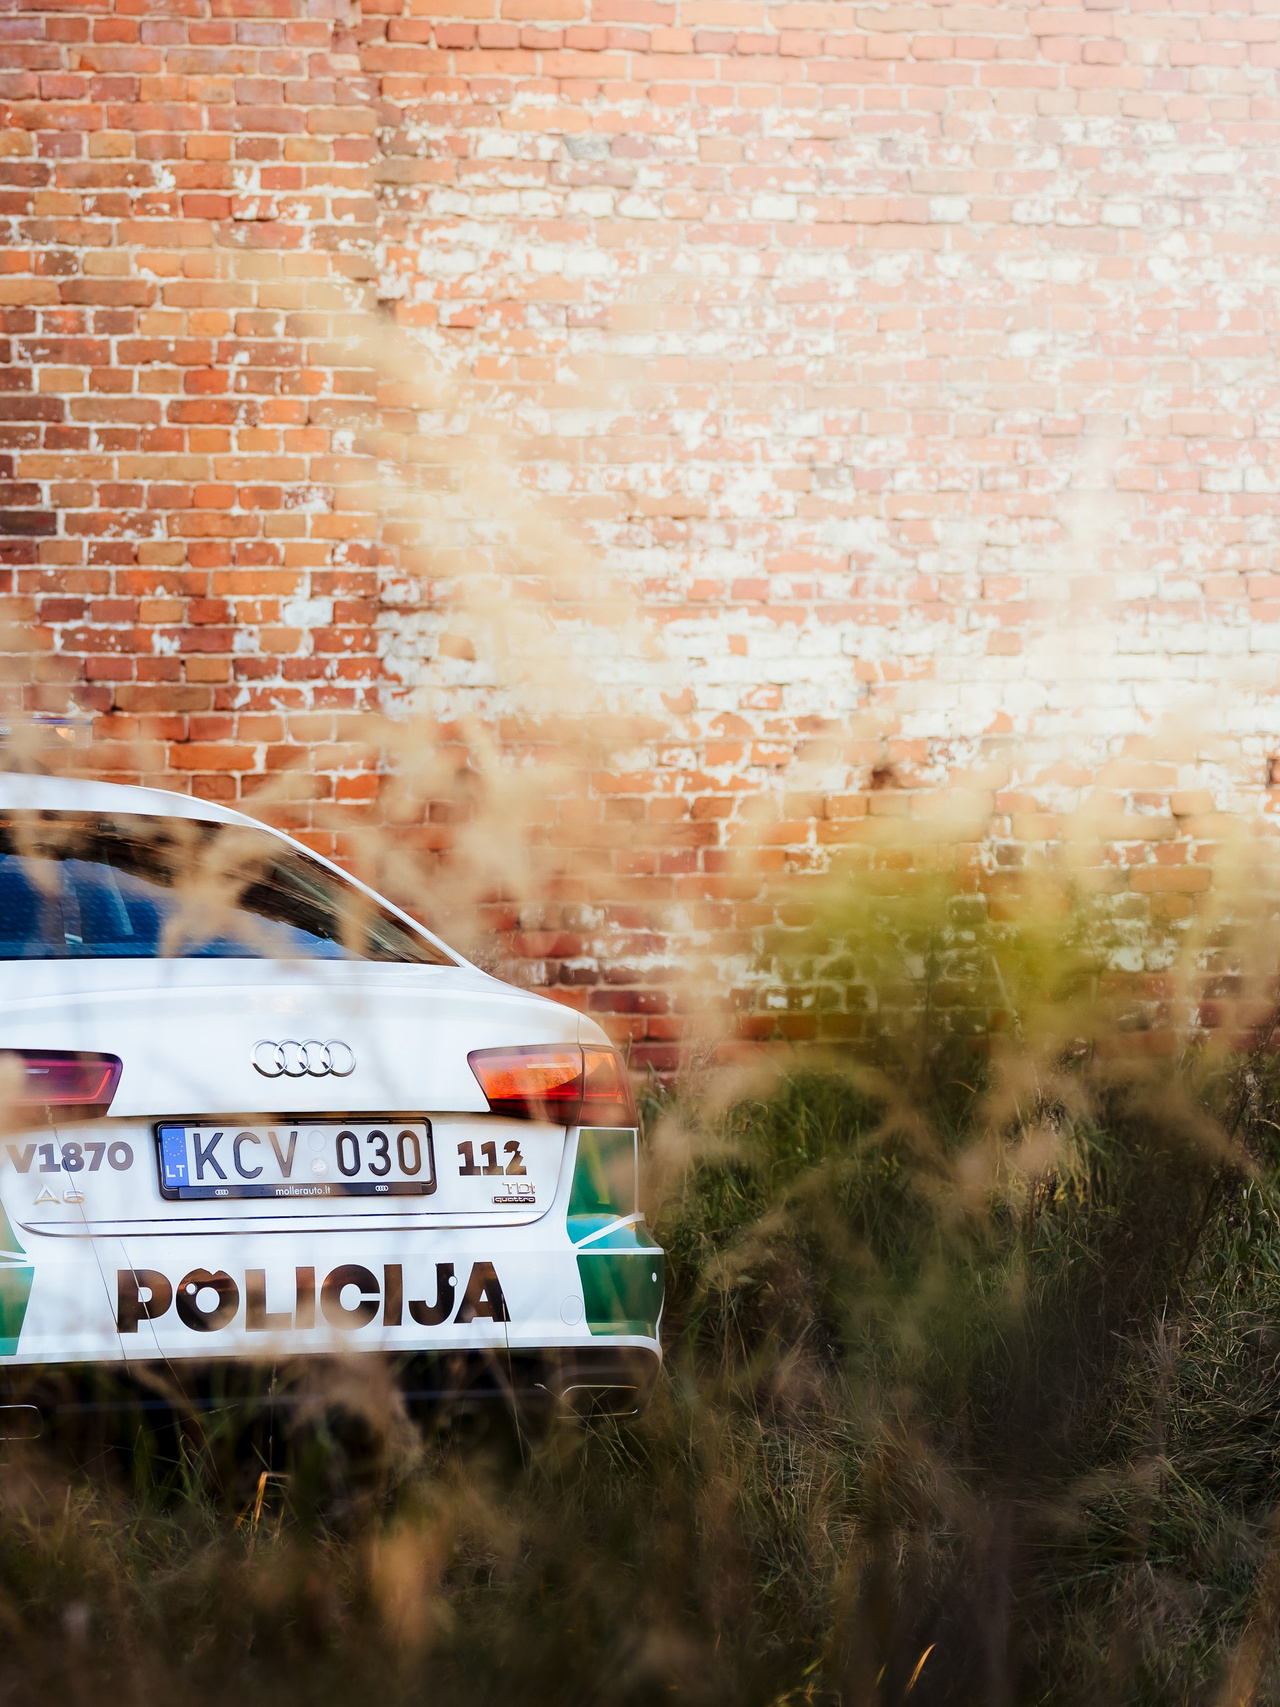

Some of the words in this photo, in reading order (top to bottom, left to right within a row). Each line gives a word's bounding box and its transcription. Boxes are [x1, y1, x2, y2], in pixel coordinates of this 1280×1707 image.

[5, 1141, 134, 1173] V1870
[193, 1131, 298, 1179] KCV
[336, 1129, 421, 1178] 030
[457, 1140, 527, 1176] 112
[166, 1164, 185, 1178] LT
[275, 1185, 331, 1196] mollerauto.lt
[494, 1196, 535, 1204] quattro
[502, 1182, 536, 1195] TDI
[116, 1261, 512, 1333] POLICIJA
